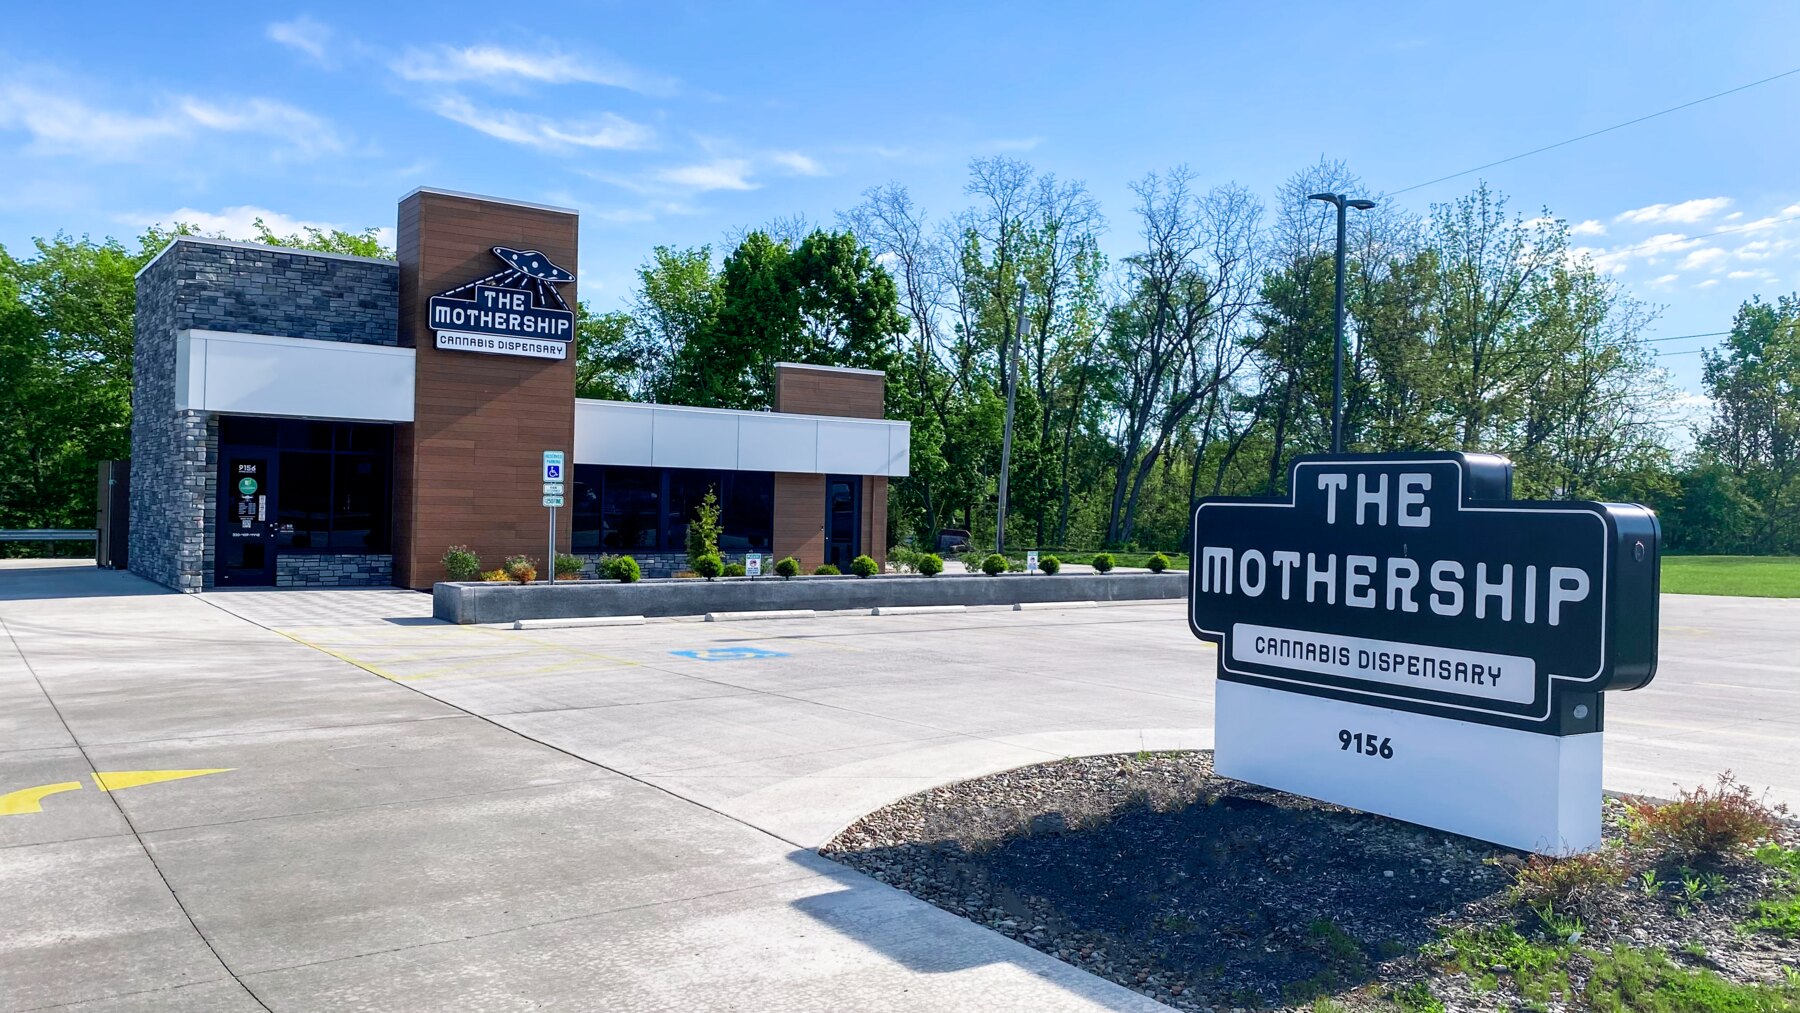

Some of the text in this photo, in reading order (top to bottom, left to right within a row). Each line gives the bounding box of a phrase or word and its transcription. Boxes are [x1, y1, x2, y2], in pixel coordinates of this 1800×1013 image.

[484, 290, 525, 311] THE
[435, 305, 569, 335] MOTHERSHIP
[440, 335, 563, 355] CANNABIS DISPENSARY
[1317, 472, 1432, 528] THE
[1201, 545, 1591, 627] MOTHERSHIP
[1255, 636, 1502, 688] CANNABIS DISPENSARY
[1337, 729, 1395, 760] 9156
